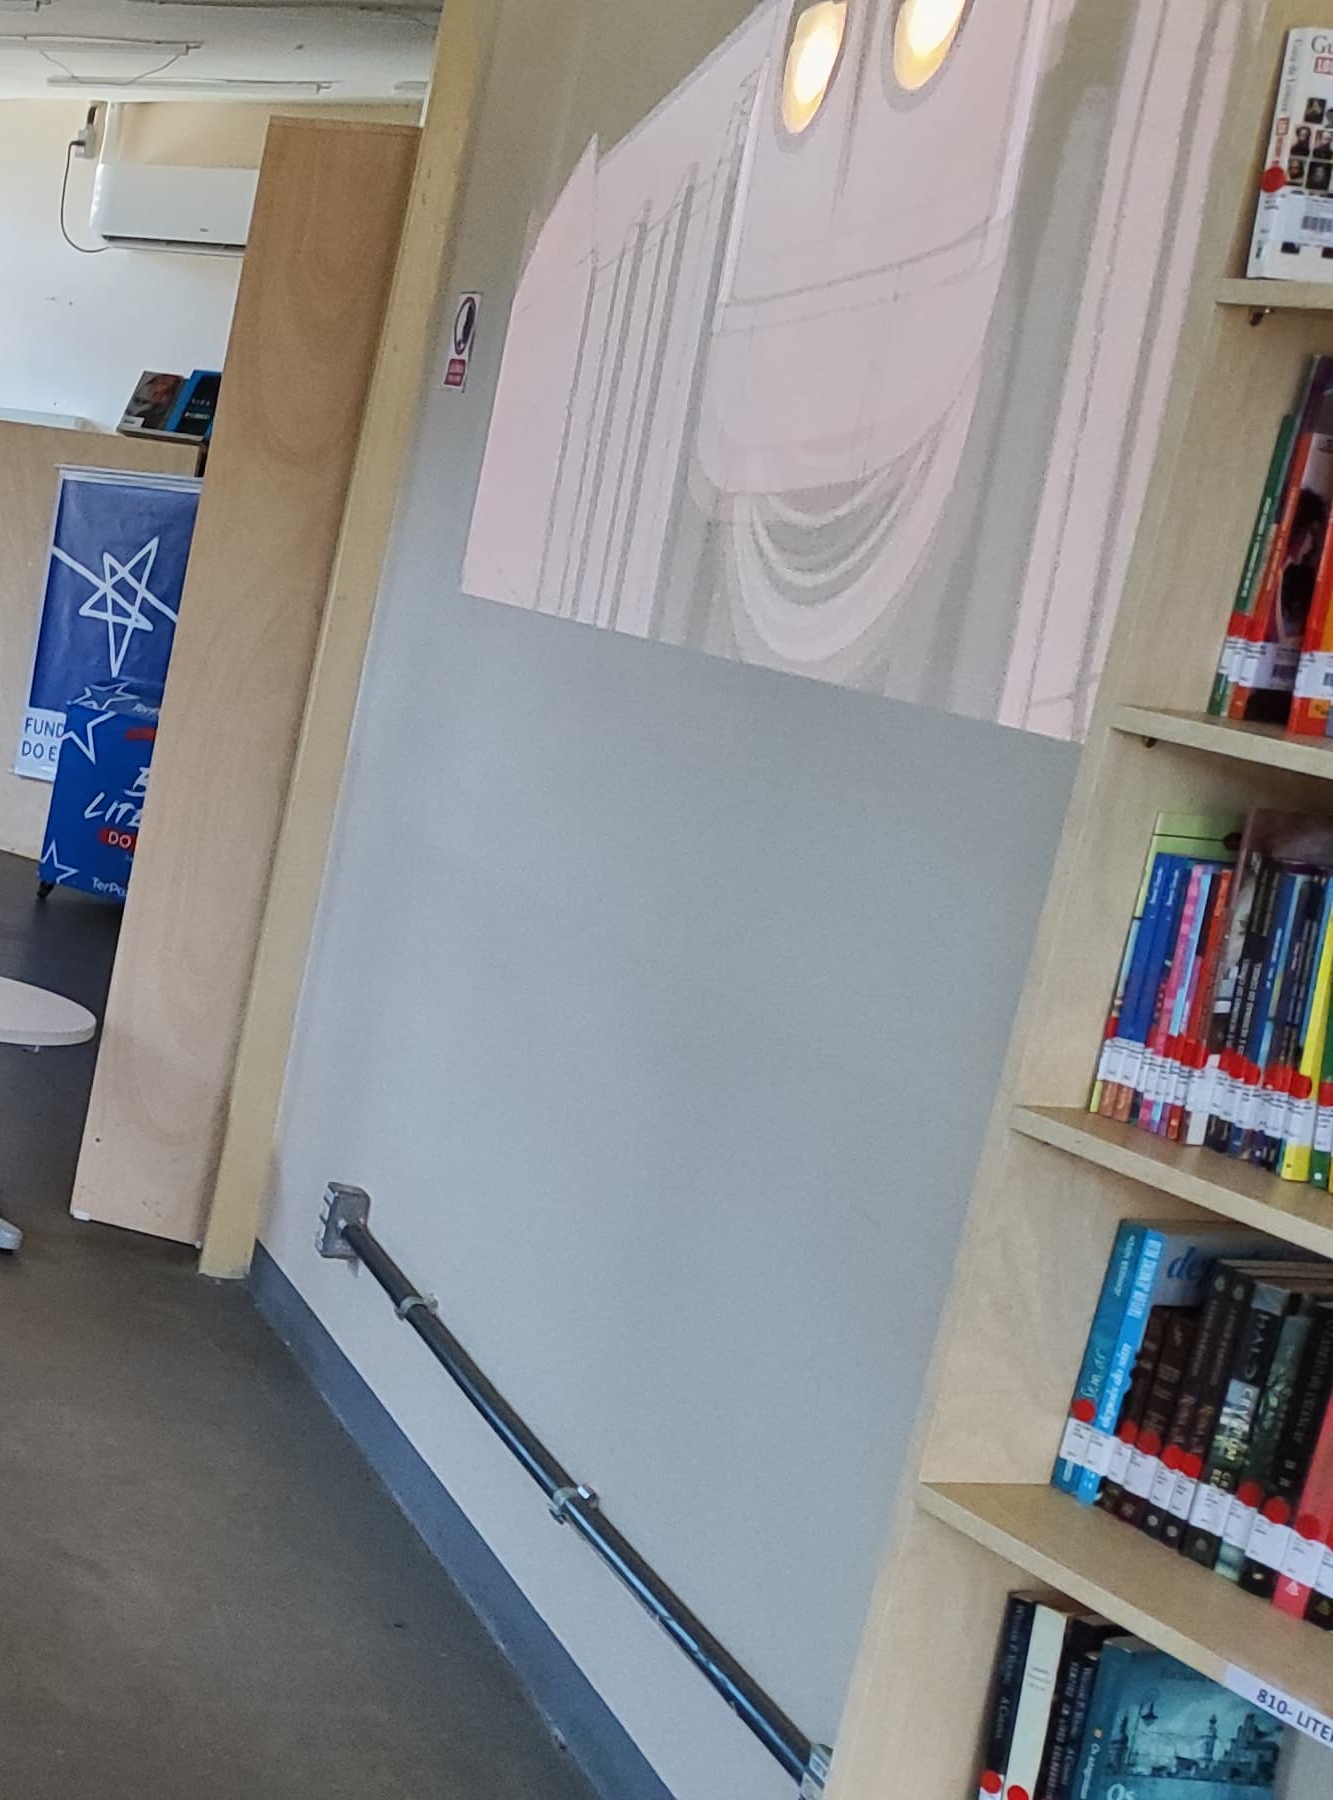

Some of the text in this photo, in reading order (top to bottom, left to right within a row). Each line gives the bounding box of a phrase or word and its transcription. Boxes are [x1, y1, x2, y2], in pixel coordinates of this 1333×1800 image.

[24, 717, 66, 739] FUND
[22, 741, 45, 759] DO
[108, 831, 132, 849] DO
[1256, 1688, 1333, 1744] 810- LITE
